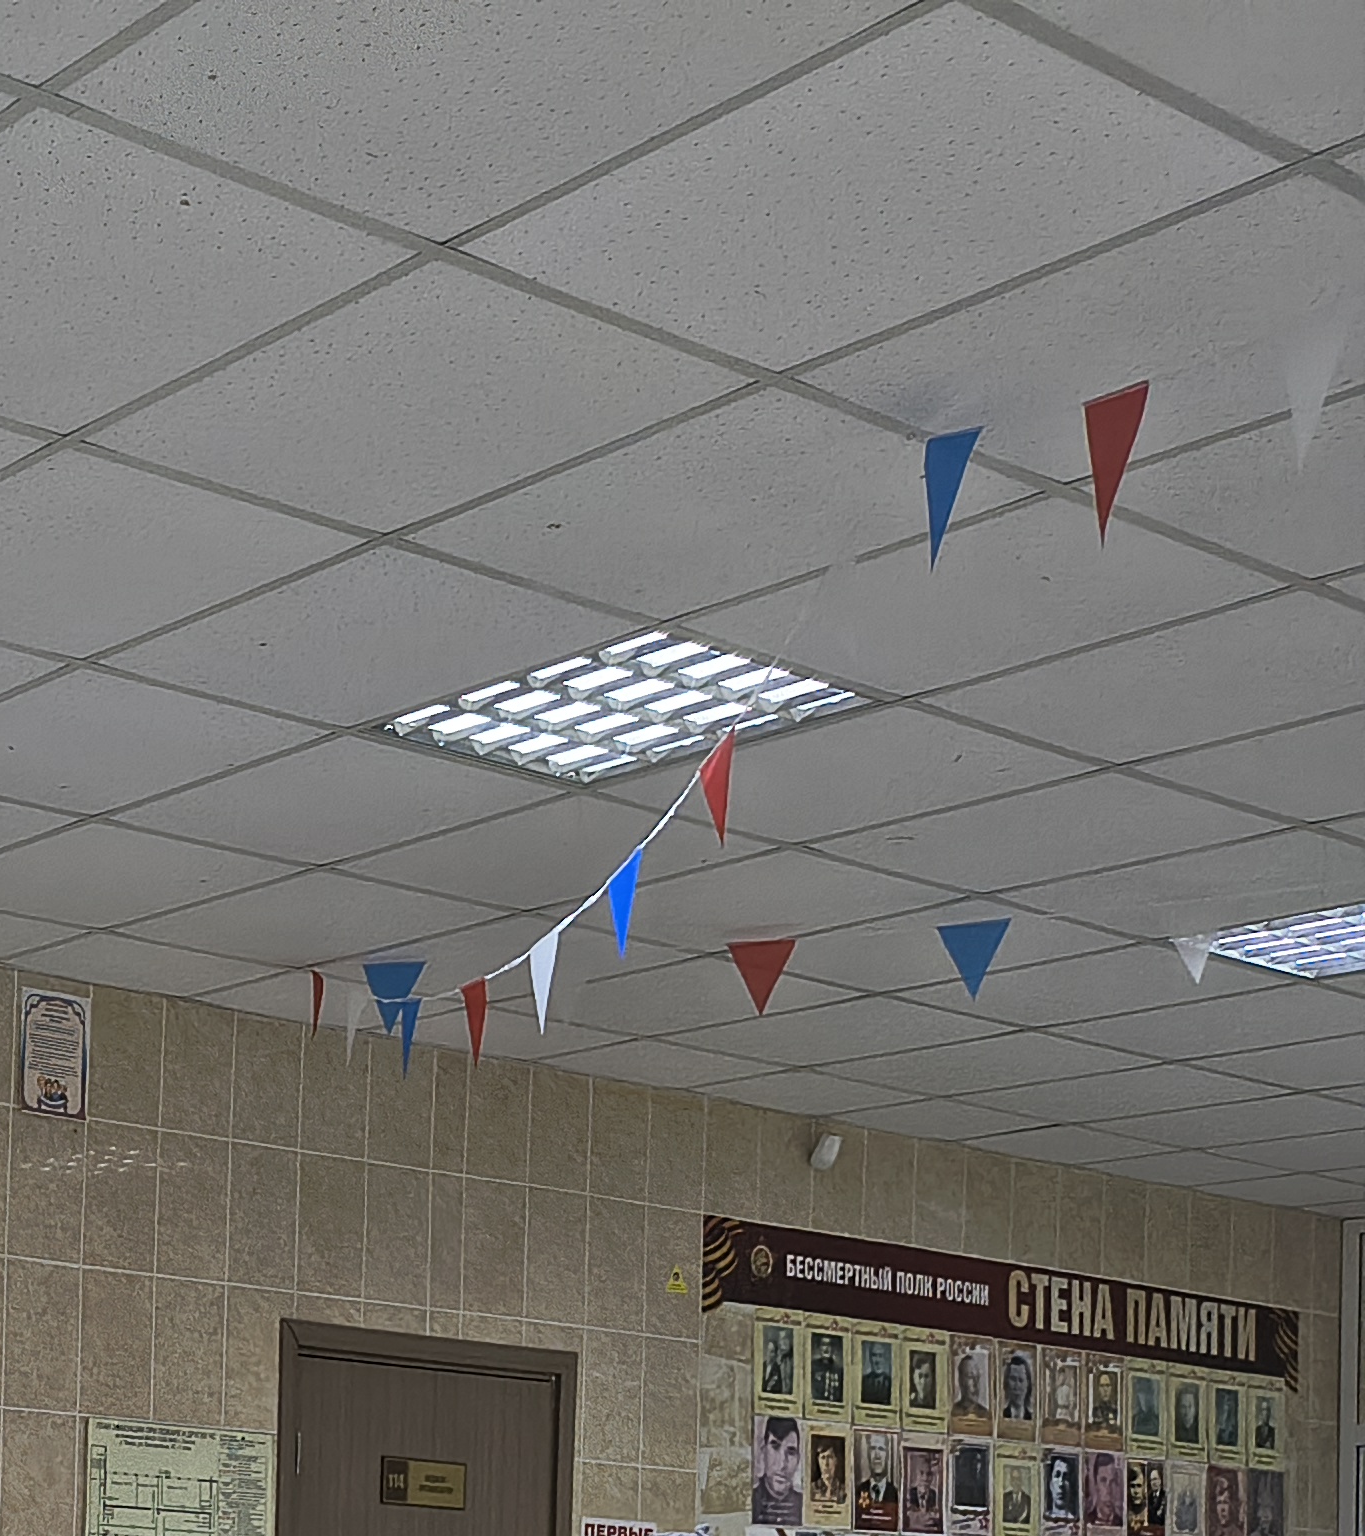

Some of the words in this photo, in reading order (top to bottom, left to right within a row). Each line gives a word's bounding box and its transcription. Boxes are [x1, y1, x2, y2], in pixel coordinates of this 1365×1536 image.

[786, 1254, 892, 1291] БЕССМЕРТНЫЙ
[896, 1272, 933, 1298] ПОЛК
[936, 1277, 989, 1306] РОССИИ
[1008, 1269, 1115, 1340] СТЕНА
[1126, 1287, 1257, 1362] ПАМЯТИ
